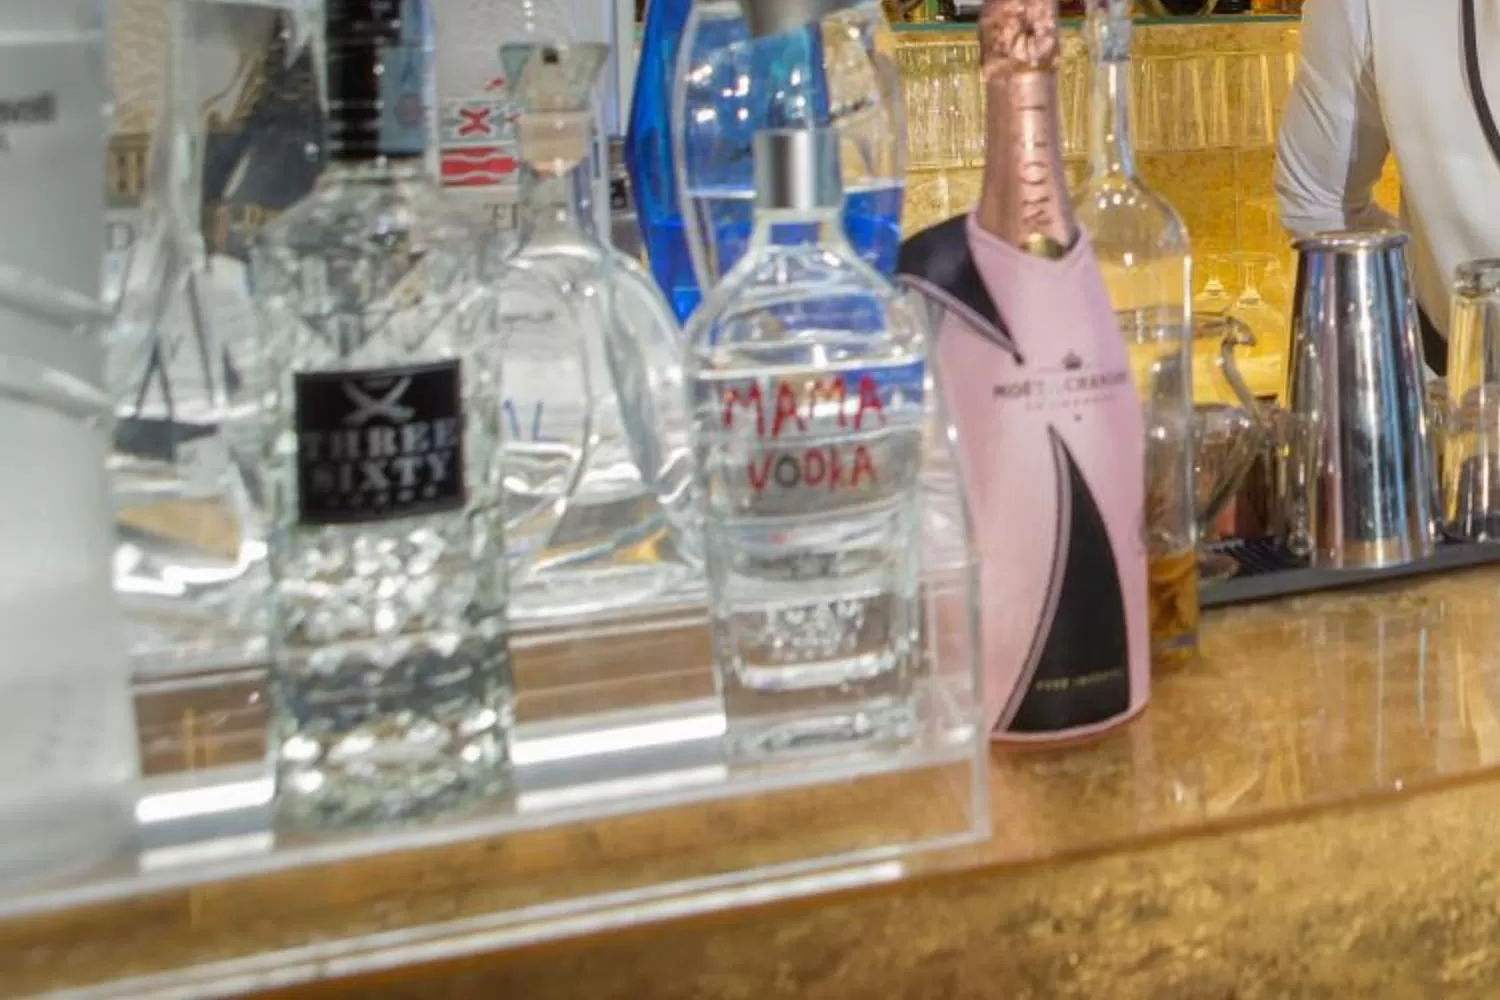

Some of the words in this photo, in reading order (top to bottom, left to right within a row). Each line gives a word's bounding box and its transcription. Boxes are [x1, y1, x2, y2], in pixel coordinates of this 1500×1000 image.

[714, 376, 887, 441] MAMA
[303, 416, 460, 461] THREE
[747, 446, 878, 494] VODKA
